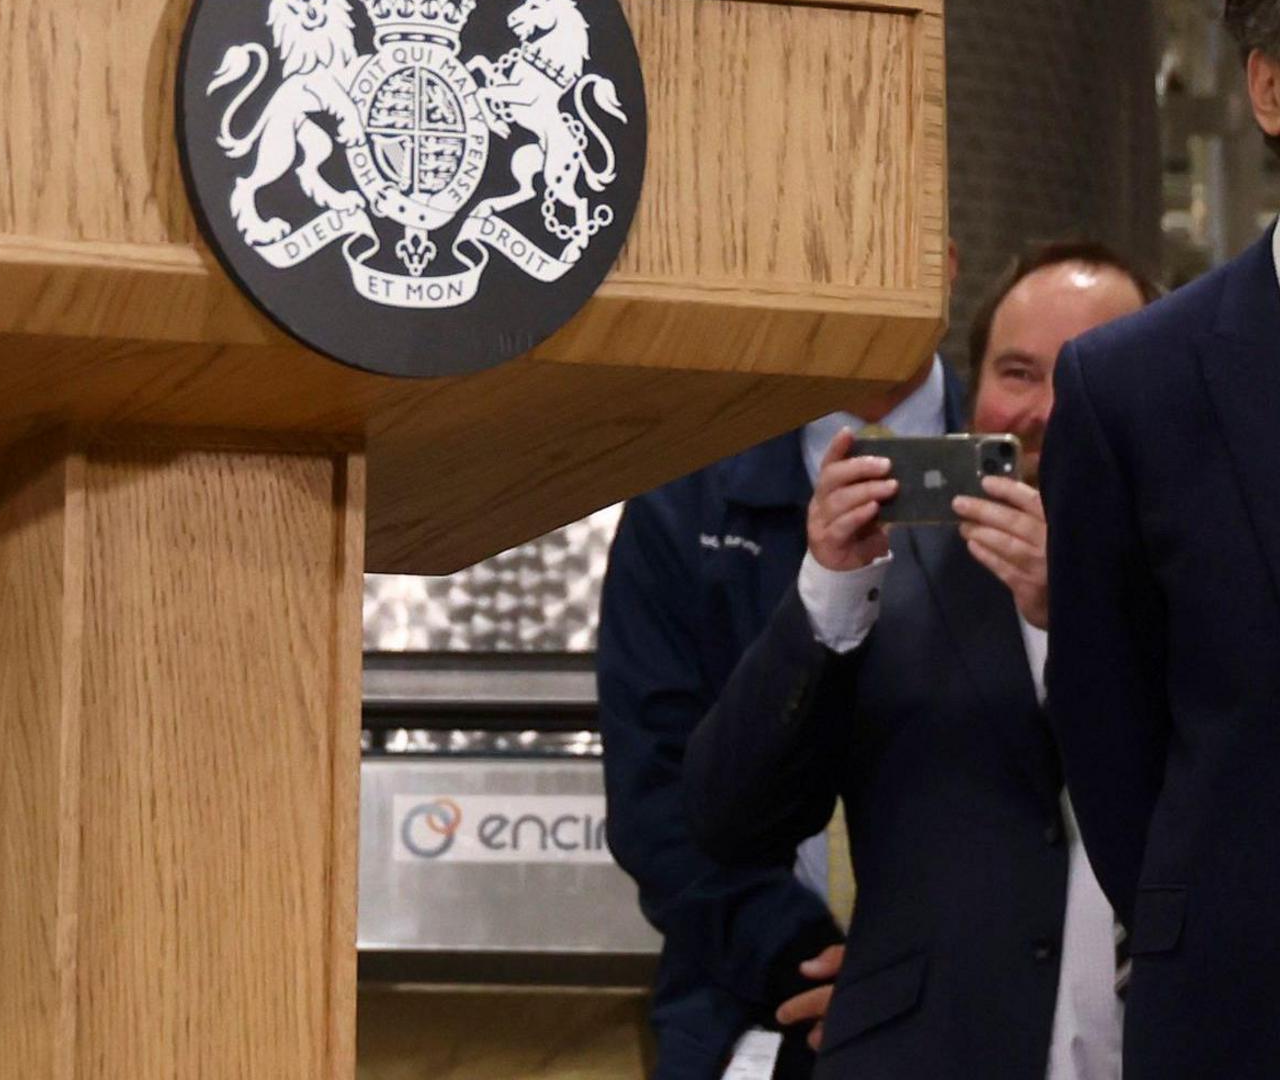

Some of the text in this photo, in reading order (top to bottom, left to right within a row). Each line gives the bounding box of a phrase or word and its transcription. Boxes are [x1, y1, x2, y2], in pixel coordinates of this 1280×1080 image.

[392, 46, 433, 64] QUI
[353, 58, 386, 108] SOIT
[440, 59, 475, 104] MAL
[448, 135, 484, 203] PENSE
[284, 213, 551, 301] DIEU ET MON DROIT
